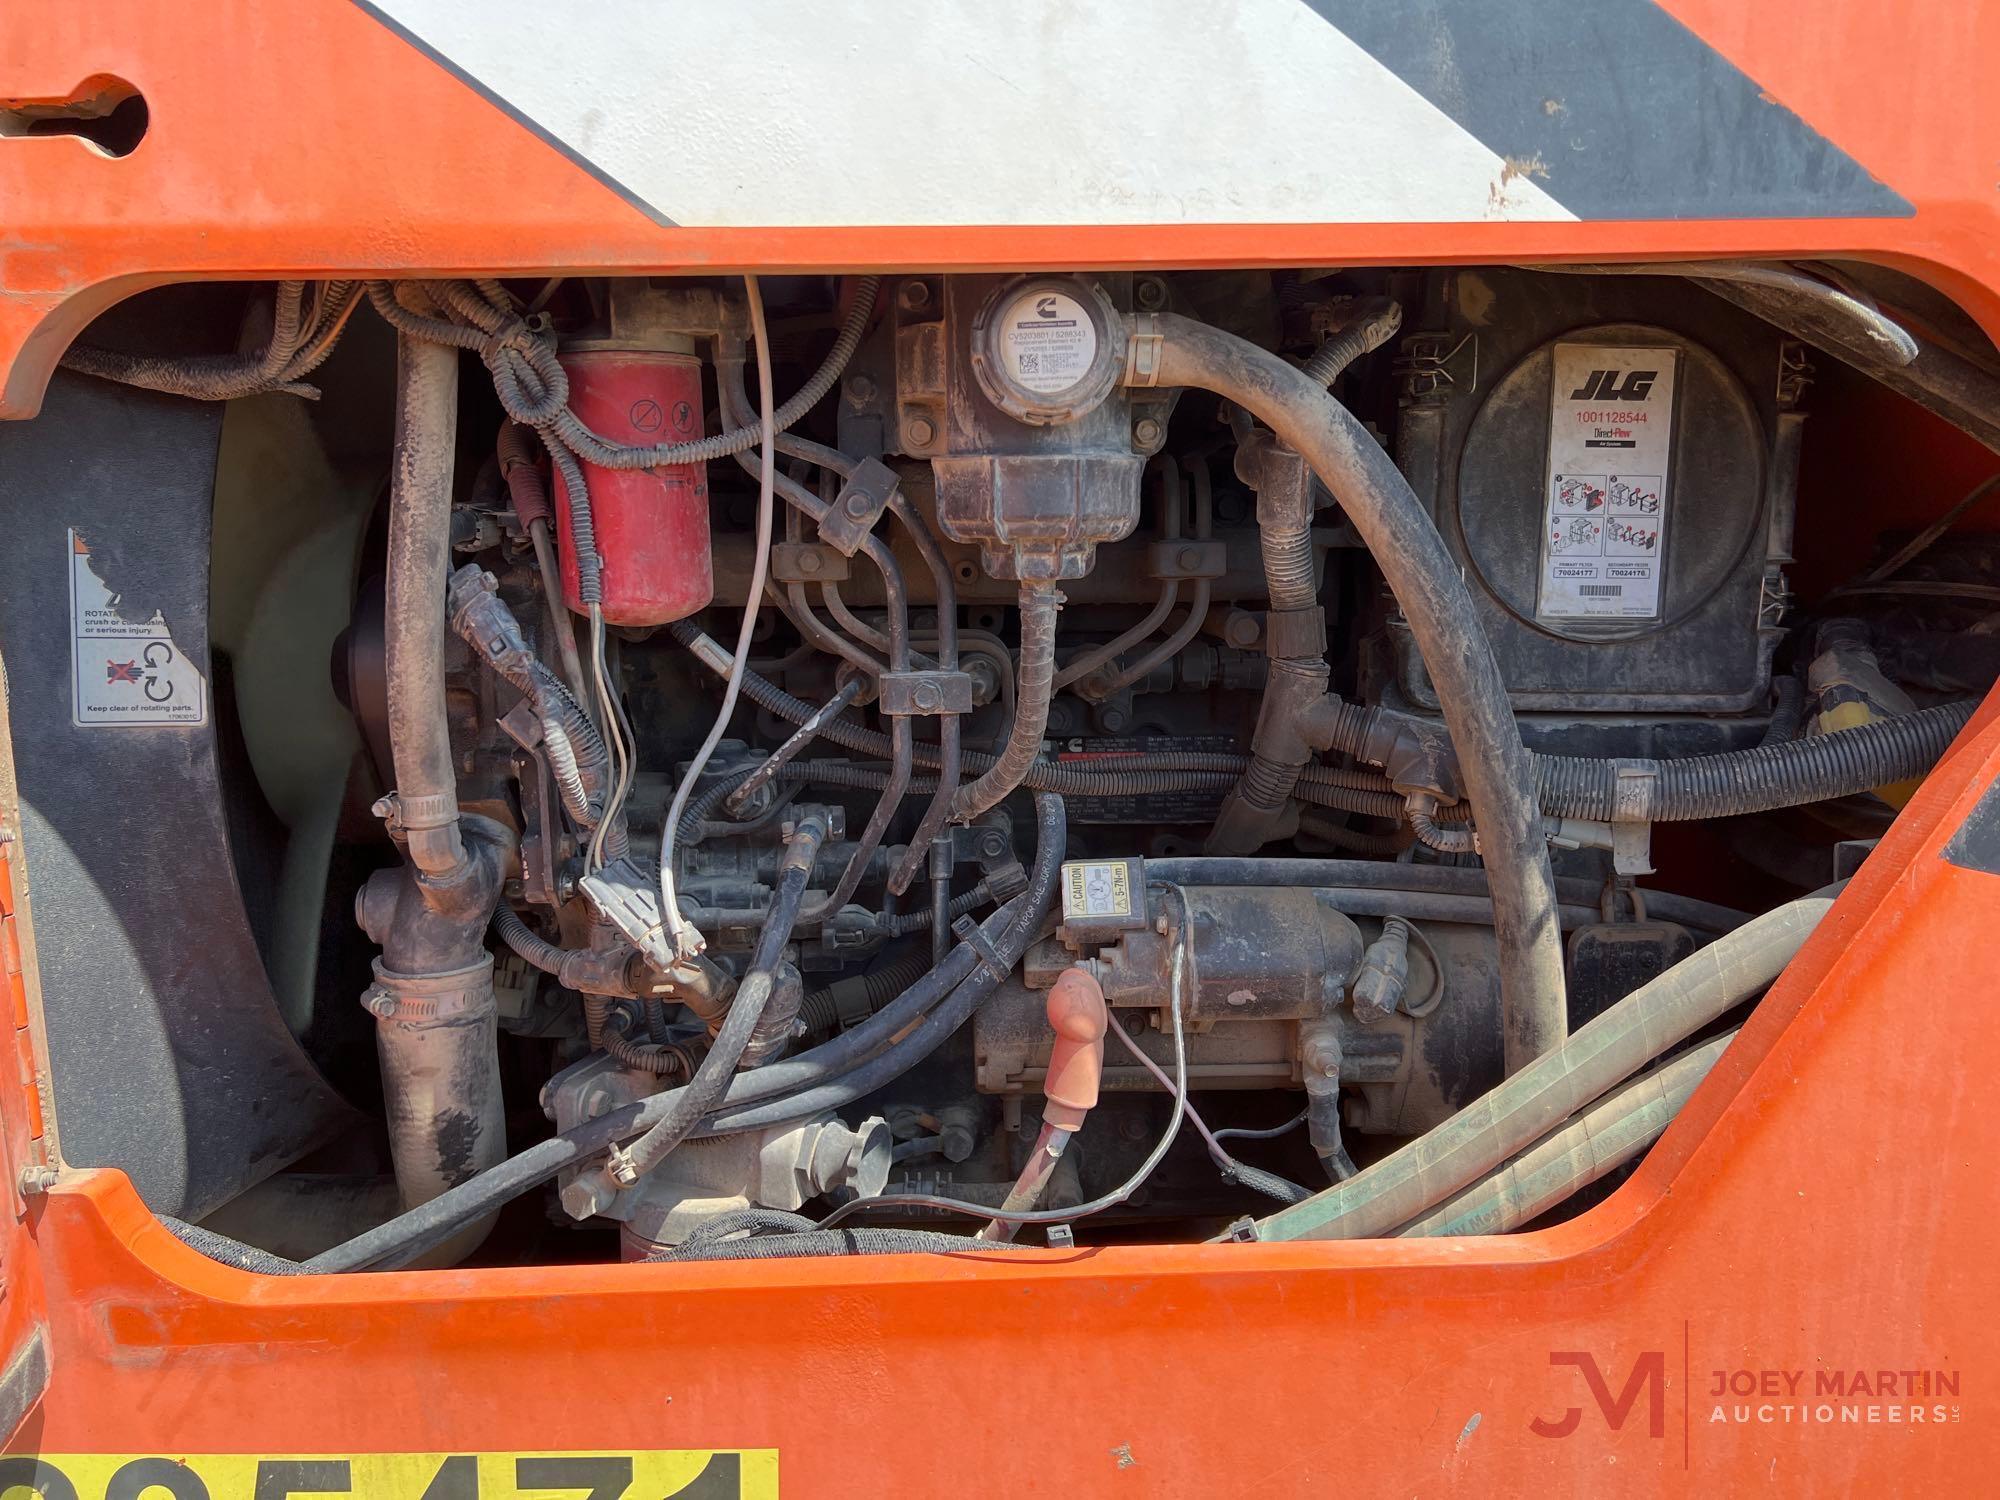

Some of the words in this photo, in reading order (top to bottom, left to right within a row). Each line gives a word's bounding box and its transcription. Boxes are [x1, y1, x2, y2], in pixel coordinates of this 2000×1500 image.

[1570, 370, 1658, 401] JLG
[1576, 411, 1648, 424] 1001128544
[1072, 867, 1084, 900] CAUTION
[1016, 904, 1036, 933] VAPOR
[1032, 885, 1046, 905] SAE
